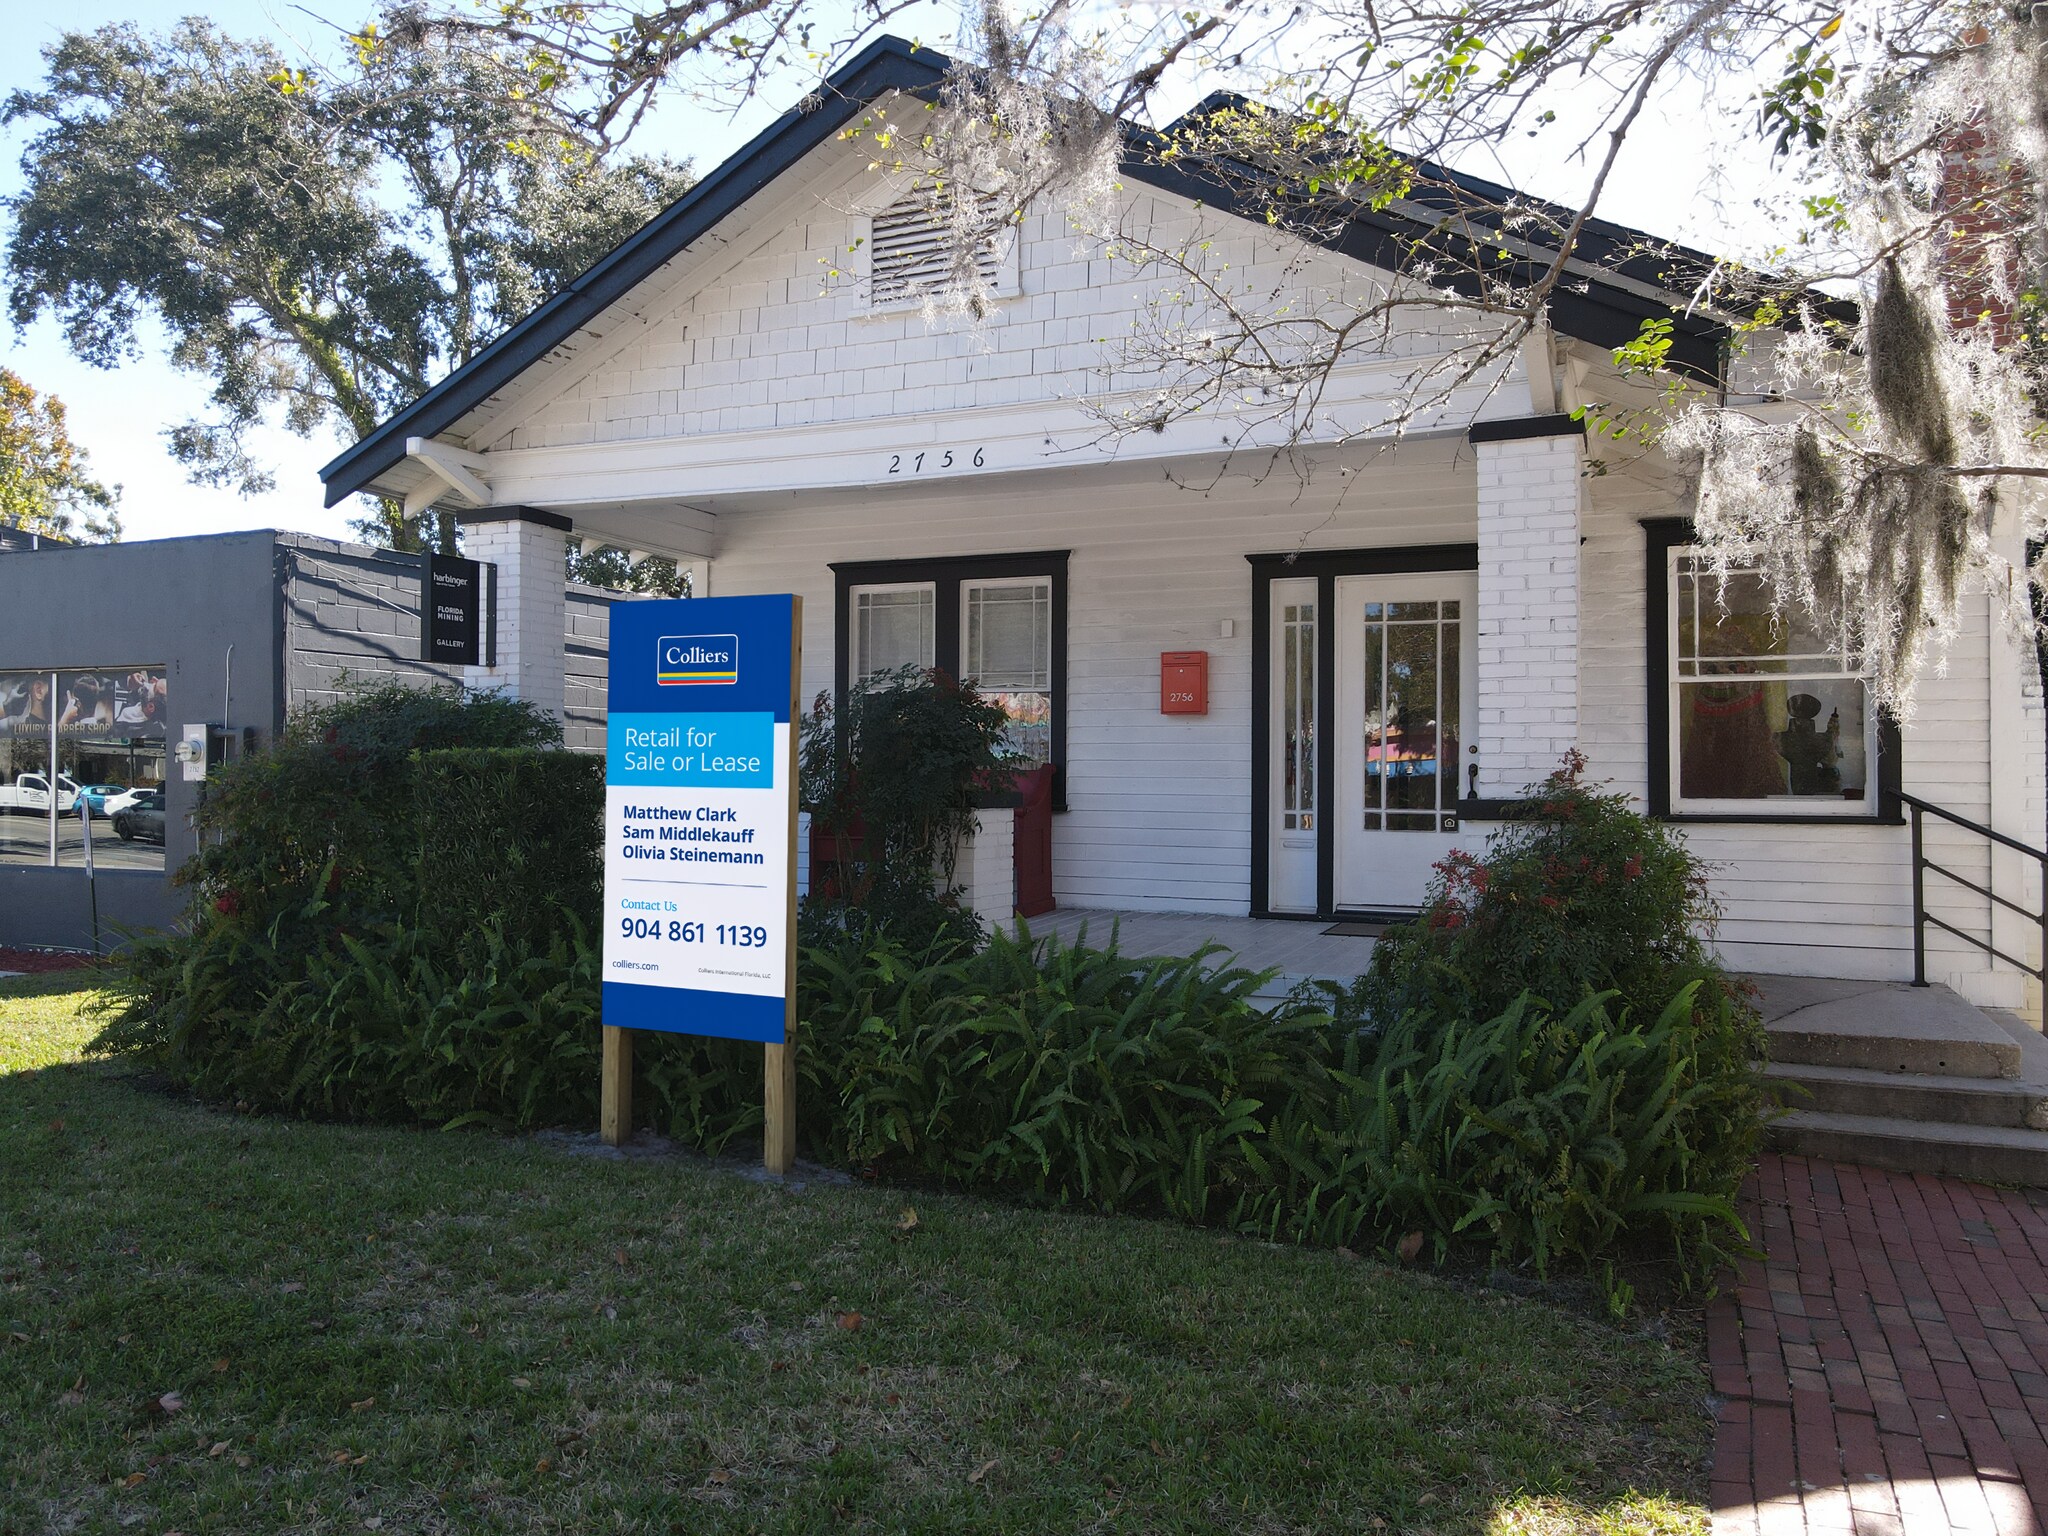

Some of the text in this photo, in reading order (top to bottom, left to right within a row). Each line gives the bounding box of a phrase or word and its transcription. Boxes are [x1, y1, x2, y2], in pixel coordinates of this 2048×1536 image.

[433, 571, 468, 587] harbinger
[437, 605, 464, 615] FLORIDA
[437, 612, 464, 622] MINING
[436, 638, 465, 648] GALLERY
[666, 646, 729, 665] Colliers
[1169, 692, 1194, 702] 2756
[14, 723, 46, 735] LUXURY
[87, 722, 111, 735] SHOP
[625, 727, 717, 748] Retail for
[624, 751, 760, 772] Sale or Lease
[623, 805, 737, 822] Matthew Clark
[623, 825, 754, 844] Sam Middlekauff
[622, 845, 764, 865] Olivia Steinemann
[621, 898, 678, 912] Contact Us
[621, 917, 767, 948] 904 861 1139
[612, 959, 659, 971] colliers.com
[715, 969, 744, 977] International
